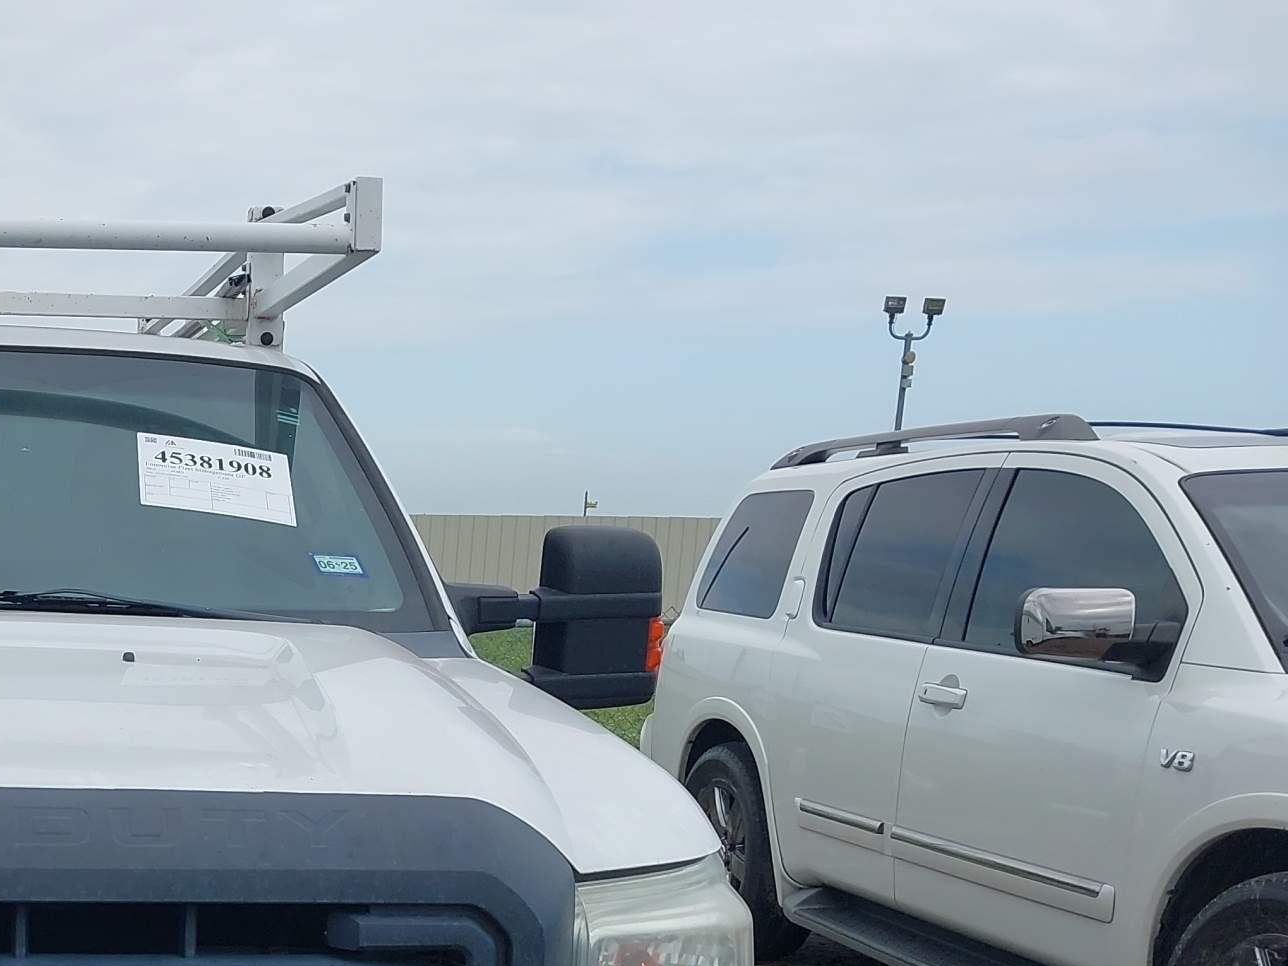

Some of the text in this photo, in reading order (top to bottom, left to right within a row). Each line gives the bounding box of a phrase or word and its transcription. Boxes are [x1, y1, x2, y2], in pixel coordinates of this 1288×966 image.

[154, 450, 273, 478] 45381908
[1160, 747, 1194, 772] V8
[14, 804, 352, 851] DUTY
